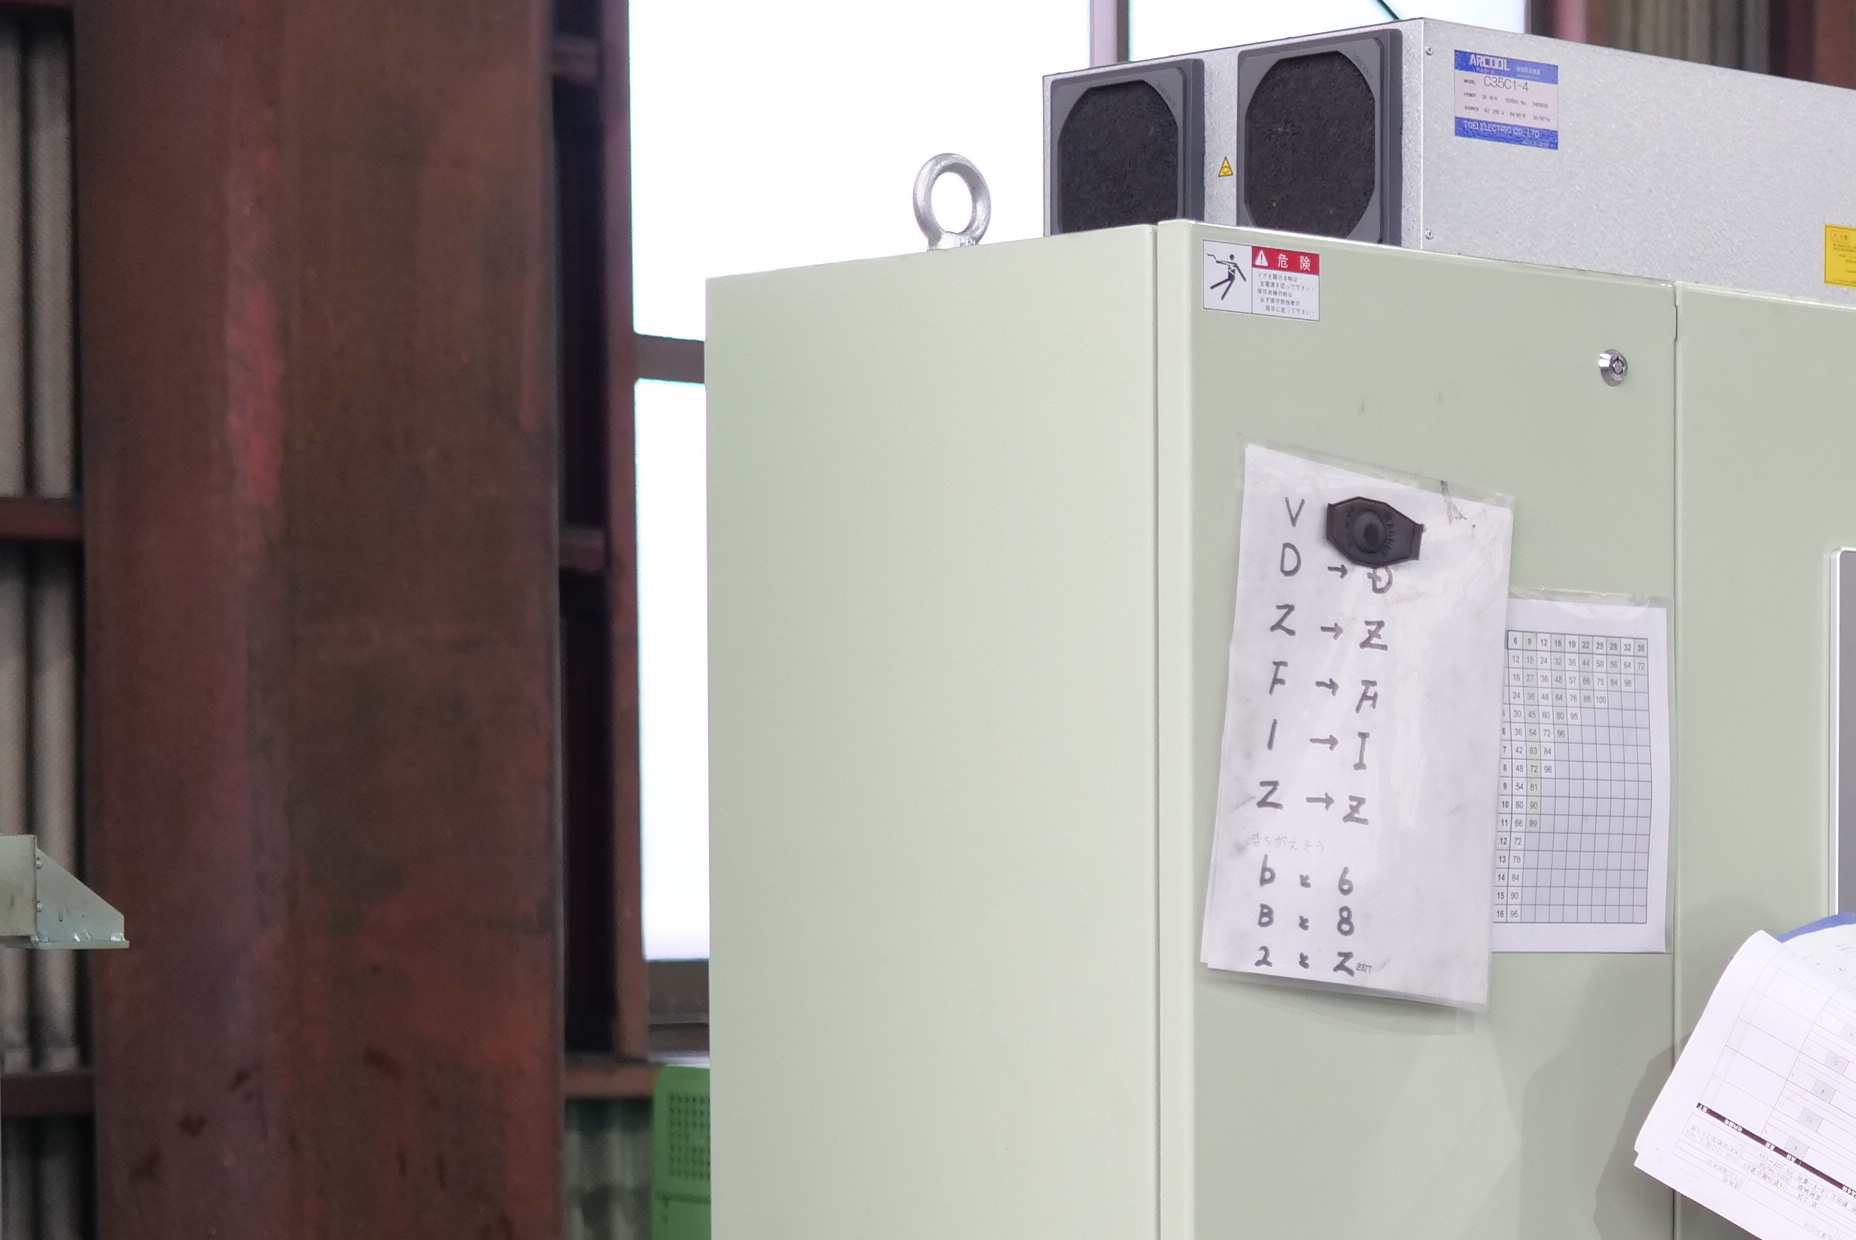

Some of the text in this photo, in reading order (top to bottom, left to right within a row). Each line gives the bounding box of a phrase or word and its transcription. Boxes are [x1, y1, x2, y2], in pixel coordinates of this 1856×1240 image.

[1469, 54, 1510, 71] ARCOOL
[1484, 76, 1529, 92] C35C1-4
[1277, 253, 1311, 271] 危険
[1285, 496, 1305, 528] V
[1280, 542, 1301, 577] D
[1270, 604, 1388, 651] Z Z
[1513, 637, 1518, 645] 6
[1568, 640, 1576, 648] 19
[1582, 641, 1590, 649] 22
[1596, 641, 1604, 650] 25
[1610, 642, 1618, 650] 28
[1623, 643, 1632, 652] 32
[1513, 655, 1520, 663] 12
[1526, 656, 1534, 664] 18
[1540, 656, 1548, 665] 24
[1554, 657, 1562, 665] 32
[1582, 658, 1590, 666] 44
[1596, 659, 1604, 668] 50
[1610, 660, 1618, 668] 56
[1624, 660, 1631, 669] 64
[1638, 661, 1645, 670] 72
[1269, 660, 1288, 695] F
[1513, 673, 1632, 687] 18 27 36 48 57 66 75 84 96
[1513, 691, 1521, 699] 24
[1541, 693, 1549, 701] 48
[1570, 694, 1578, 702] 76
[1596, 695, 1607, 704] 100
[1513, 709, 1579, 720] 30 45 60 80 95
[1514, 728, 1523, 736] 36
[1529, 729, 1537, 737] 54
[1543, 729, 1551, 738] 72
[1502, 746, 1552, 755] 7 42 63 84
[1502, 764, 1552, 773] 8 48 72 96
[1503, 783, 1538, 791] 9 54 81
[1256, 781, 1369, 825] Z Z
[1501, 801, 1538, 810] 10 60 90
[1501, 819, 1538, 827] 11 66 99
[1252, 832, 1325, 854] まちがえそう
[1500, 837, 1522, 846] 12 72
[1499, 855, 1521, 864] 13 78
[1338, 866, 1354, 896] 6
[1498, 874, 1520, 882] 14 84
[1497, 892, 1519, 900] 15 90
[1258, 903, 1274, 927] B
[1337, 905, 1354, 936] 8
[1496, 910, 1518, 918] 16 96
[1254, 945, 1273, 967] 2
[1333, 951, 1355, 977] Z
